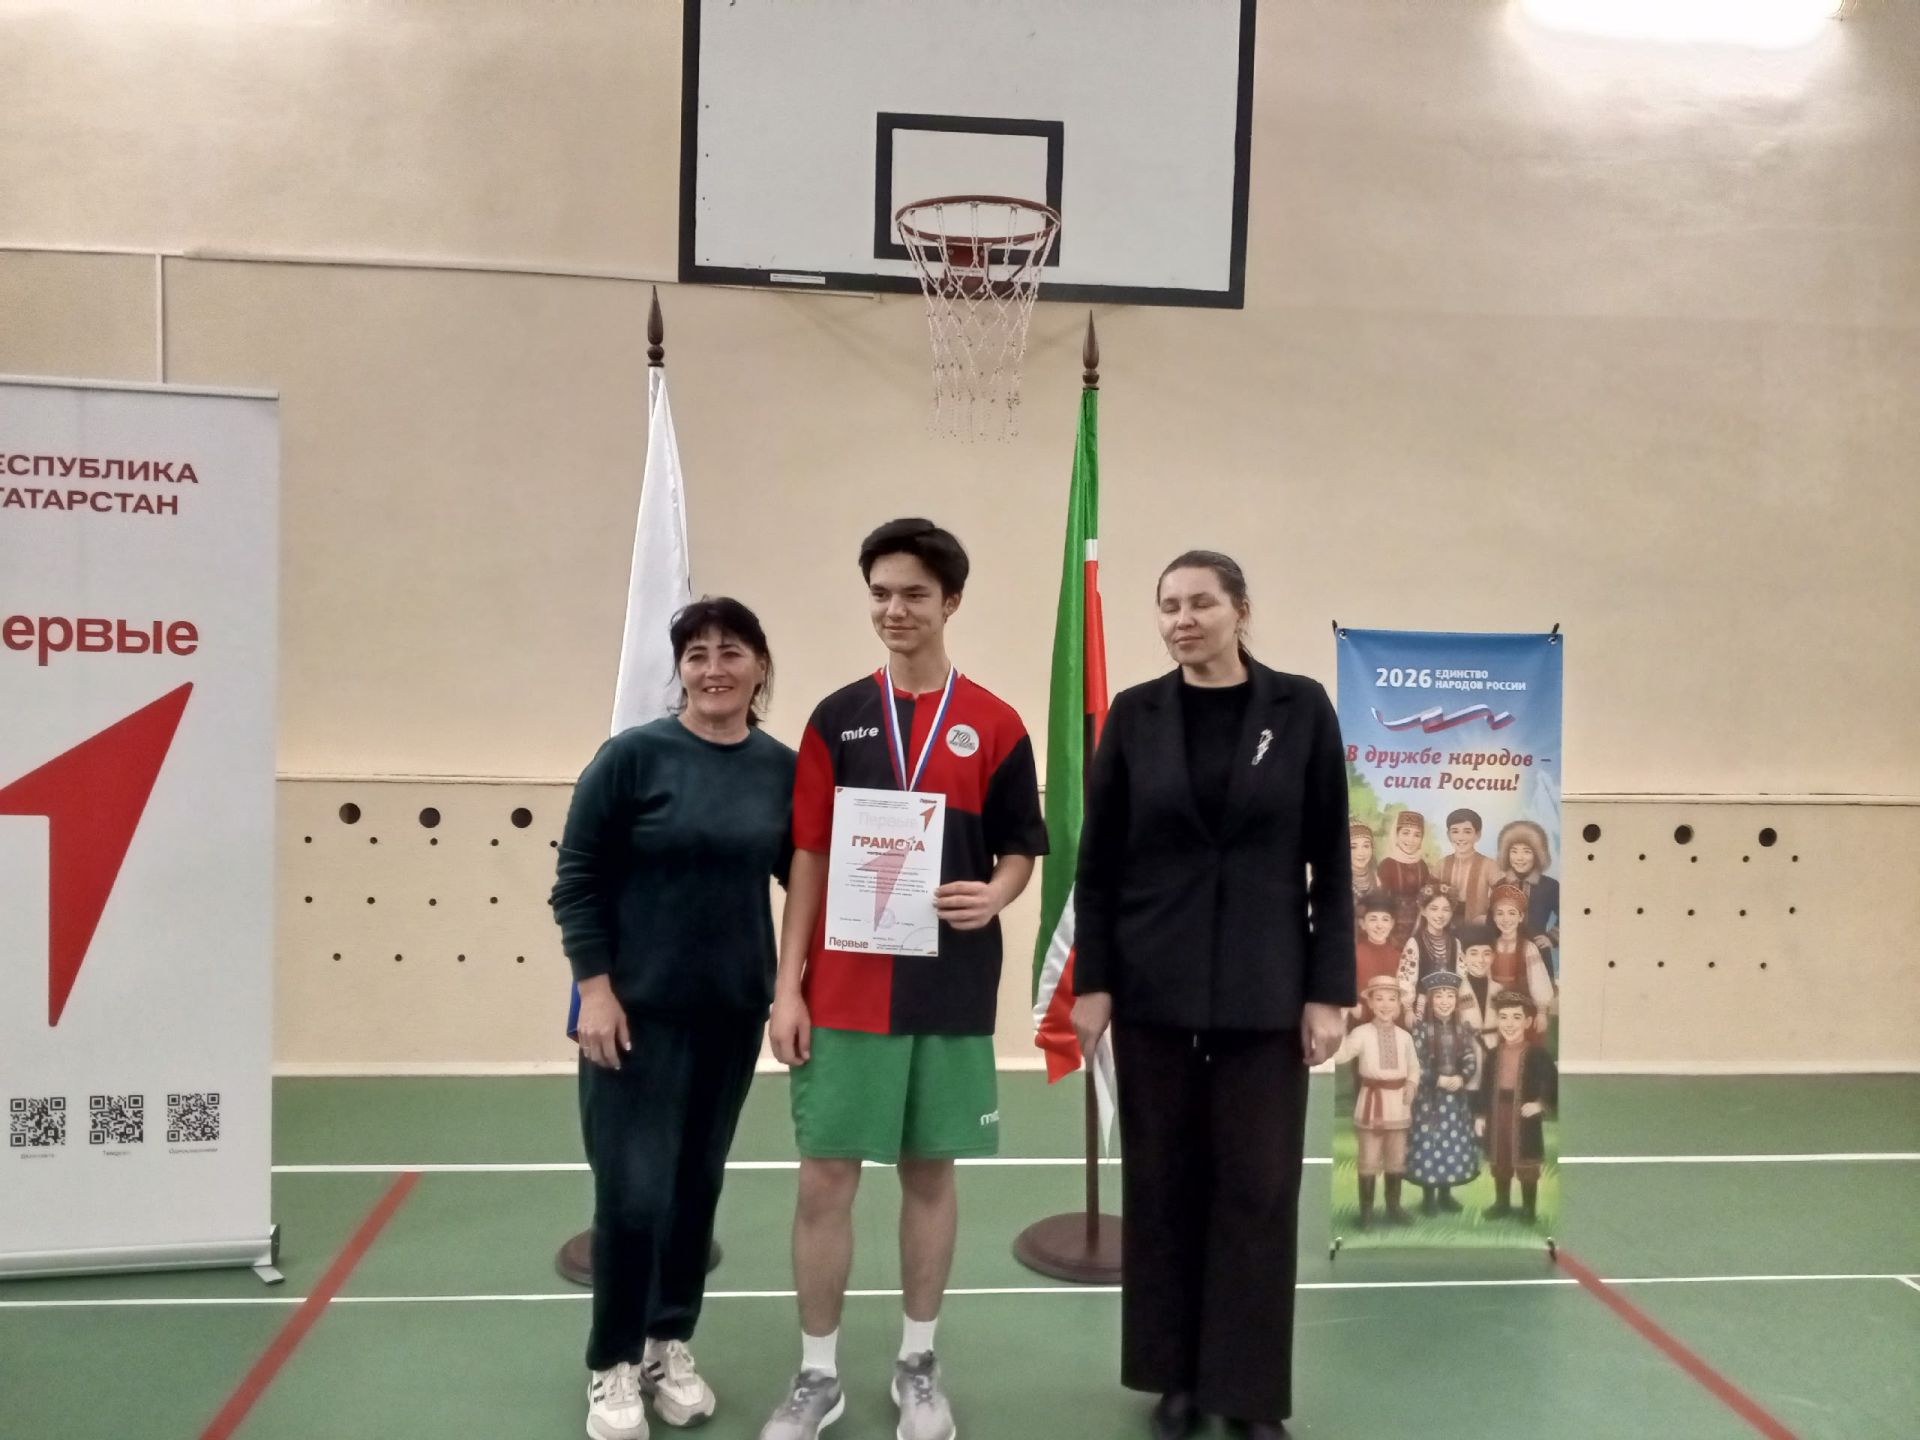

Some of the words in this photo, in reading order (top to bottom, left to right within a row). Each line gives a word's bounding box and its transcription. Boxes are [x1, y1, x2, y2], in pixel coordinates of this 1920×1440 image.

[0, 454, 199, 483] СПУБЛИКА
[0, 487, 178, 515] АТАРСТАН
[2, 615, 199, 666] ервые
[1376, 668, 1432, 688] 2026
[1435, 669, 1489, 680] ЕДИНСТВО
[1435, 681, 1484, 691] НАРОДОВ
[1486, 681, 1527, 691] РОССИИ
[841, 726, 880, 742] mitre
[1344, 744, 1359, 762] В
[1365, 744, 1442, 769] дружбе
[1448, 748, 1534, 771] народов
[1383, 774, 1431, 790] сила
[1437, 772, 1520, 791] России!
[829, 936, 869, 949] Первые
